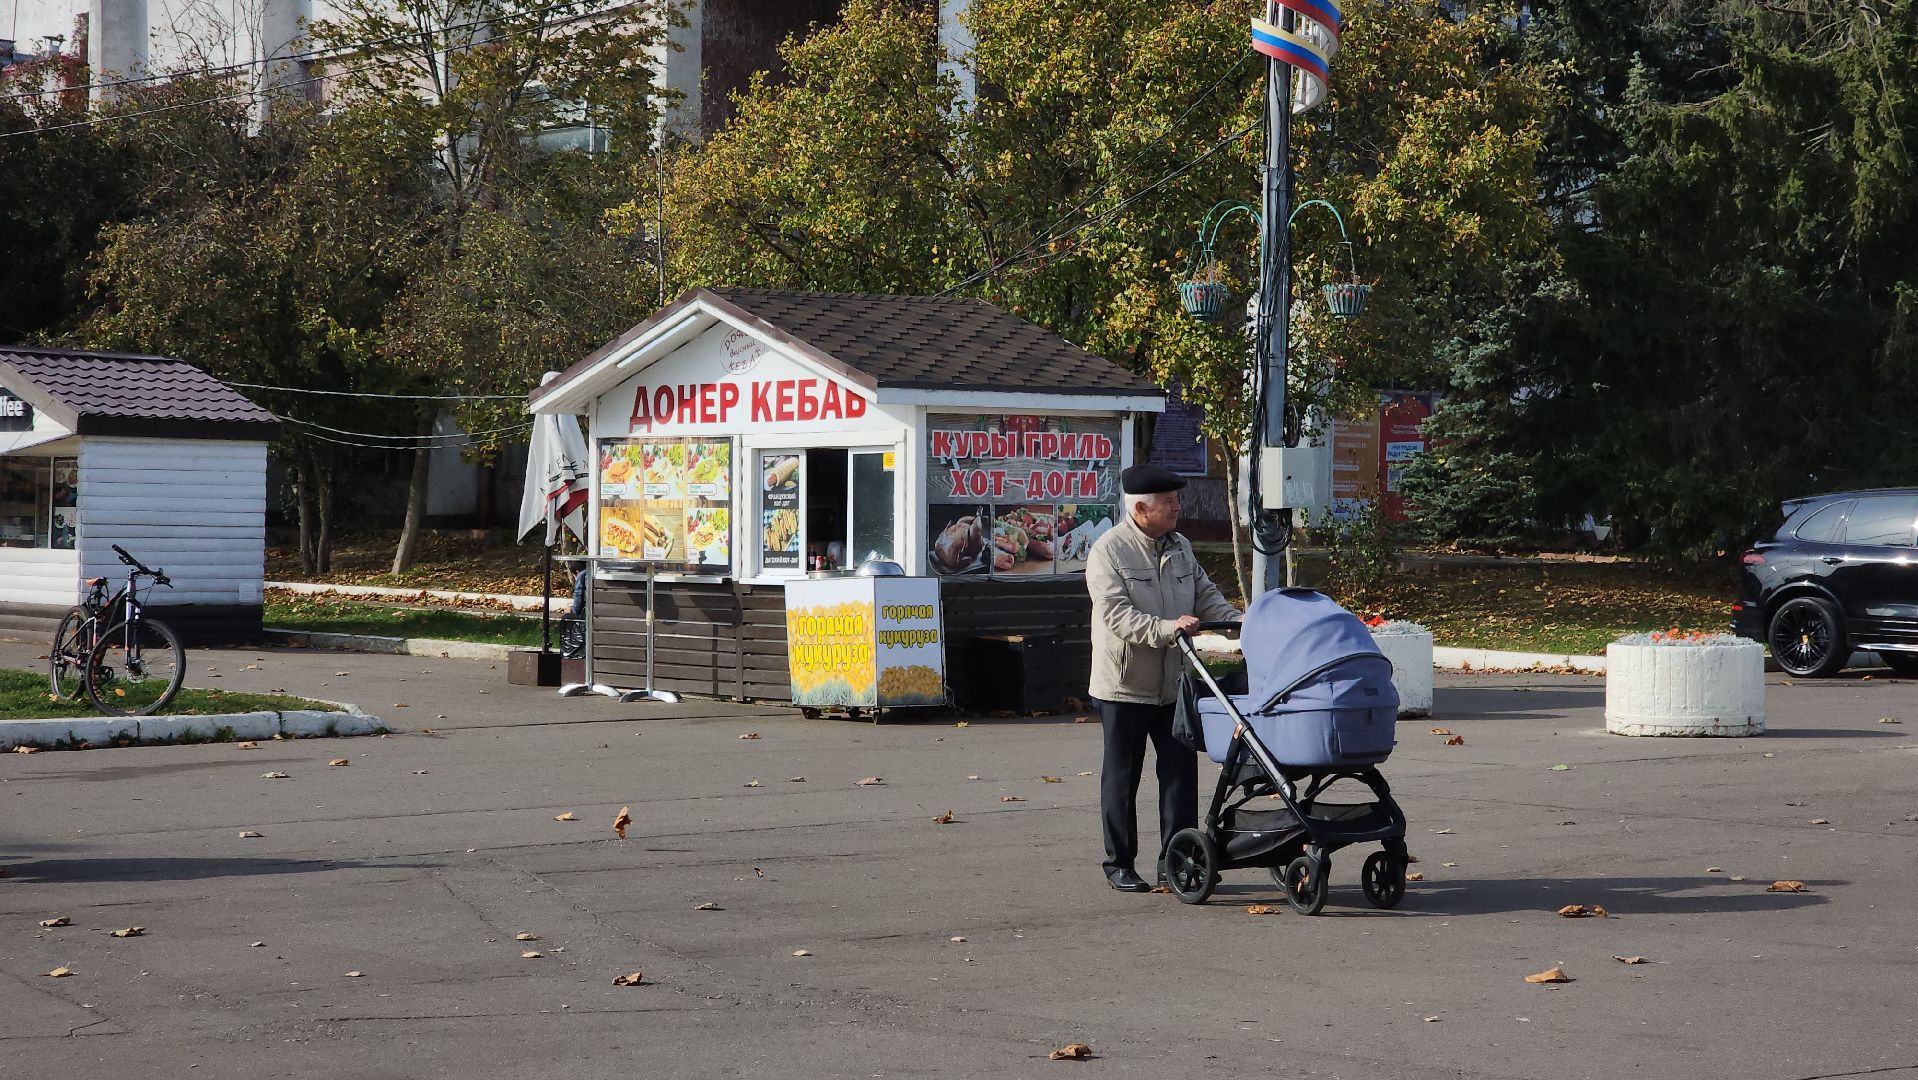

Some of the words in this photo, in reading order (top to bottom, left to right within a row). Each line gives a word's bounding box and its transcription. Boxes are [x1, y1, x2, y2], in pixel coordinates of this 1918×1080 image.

[629, 382, 739, 433] ДОНЕР
[751, 379, 867, 422] КЕБАБ
[932, 429, 1018, 460] КУРЫ
[1024, 431, 1113, 460] ГРИЛЬ
[798, 614, 864, 642] горячая
[881, 604, 934, 624] горячая
[878, 629, 938, 649] кукуруза
[794, 642, 869, 672] кукуруза
